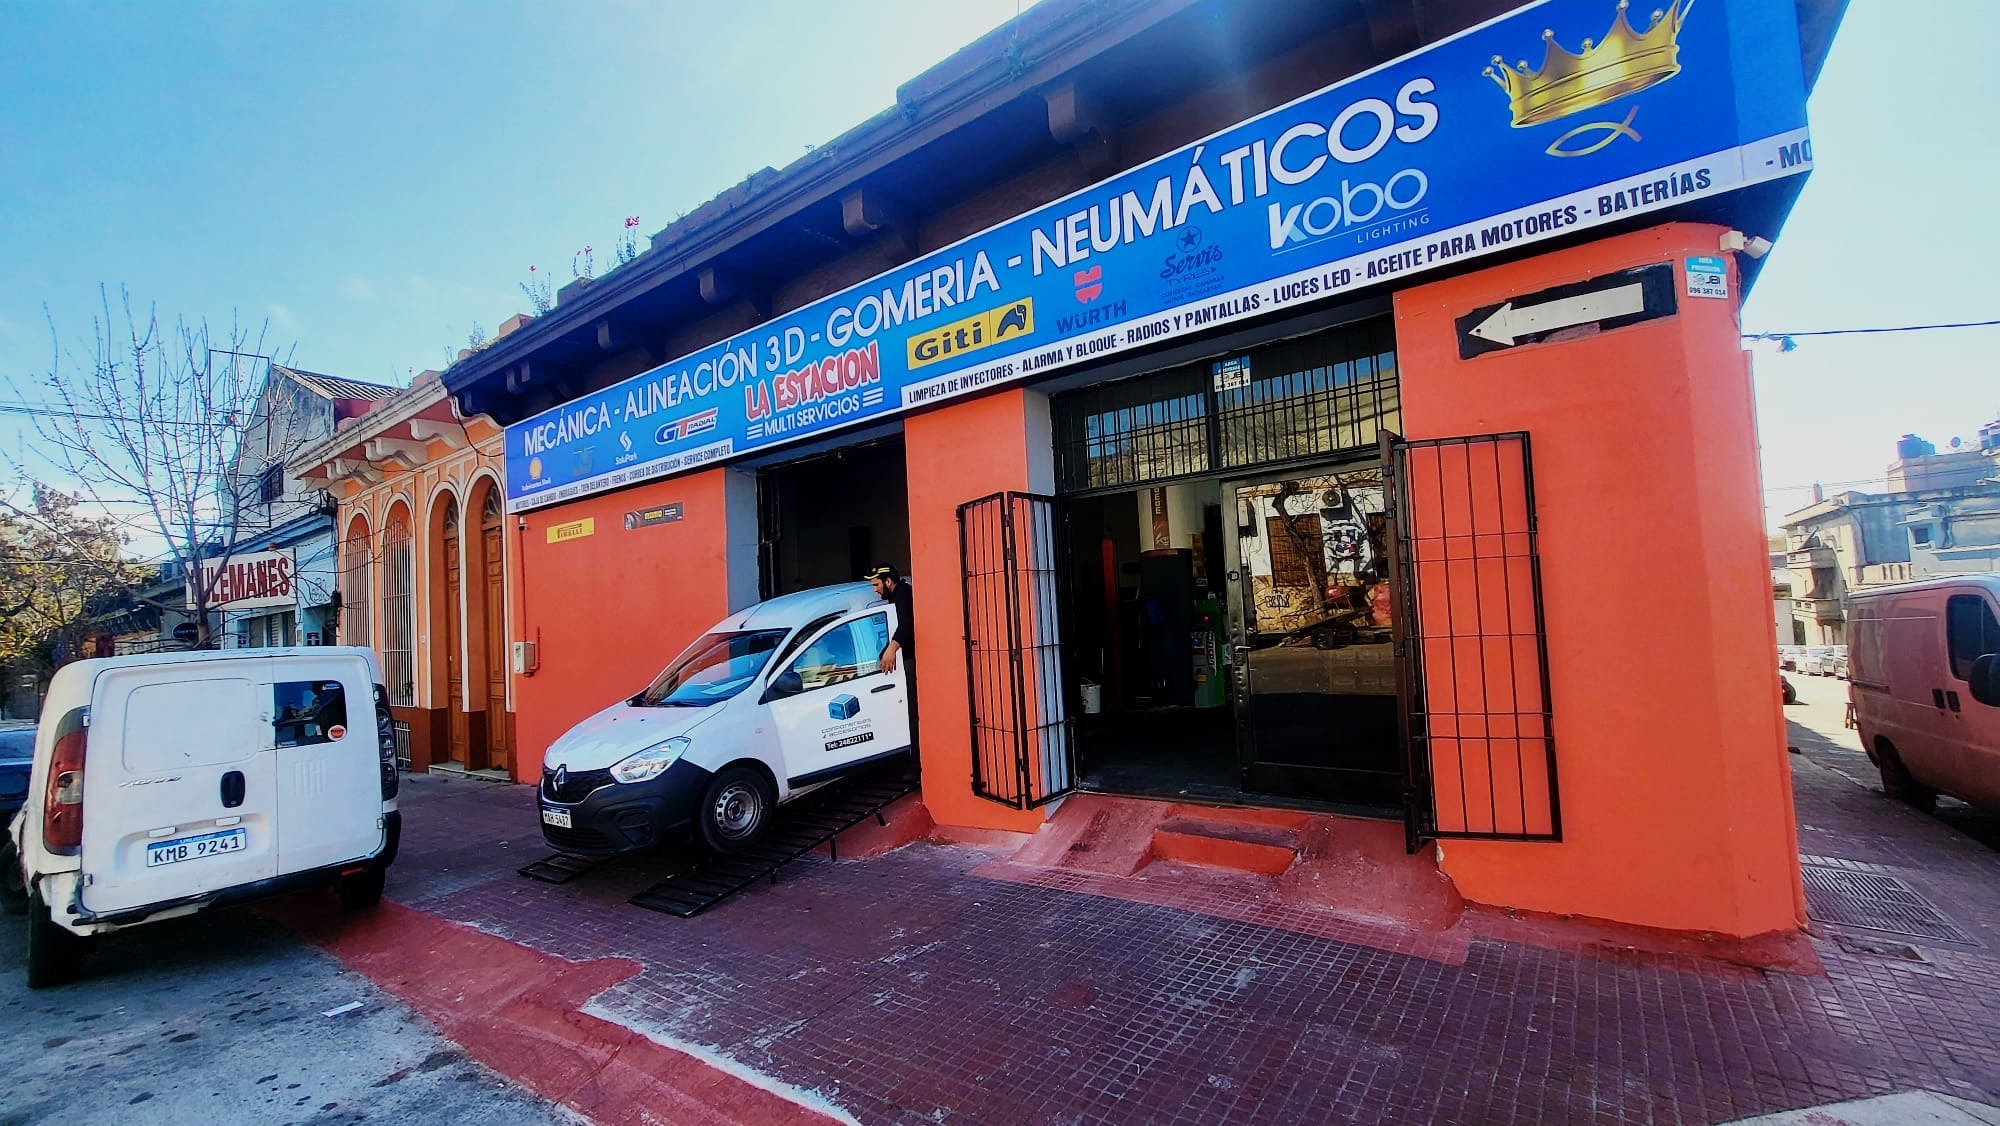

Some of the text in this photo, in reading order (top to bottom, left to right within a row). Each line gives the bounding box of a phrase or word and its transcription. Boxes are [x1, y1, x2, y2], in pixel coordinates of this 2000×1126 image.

[1357, 213, 1430, 244] LIGHTING
[524, 402, 611, 457] MECÁNICA
[624, 341, 758, 423] ALINEACIÓN
[765, 326, 805, 372] 3D
[826, 250, 1000, 348] GOMERIA
[1031, 78, 1439, 277] NEUMÁTICOS
[908, 384, 947, 403] LIMPIEZA
[948, 381, 959, 392] DE
[960, 364, 1014, 390] INYECTORES
[1022, 349, 1064, 373] ALARMA
[1066, 346, 1074, 359] Y
[1076, 334, 1118, 357] BLOQUE
[1127, 320, 1170, 344] RADIOS
[1173, 315, 1181, 331] Y
[1185, 293, 1260, 328] PANTALLAS
[1273, 277, 1319, 303] LUCES
[1323, 267, 1351, 290] LED
[1367, 248, 1423, 278] ACEITE
[1427, 234, 1476, 262] PARA
[1481, 205, 1578, 247] MOTORES
[1598, 168, 1711, 217] BATERÍAS
[1057, 300, 1127, 334] WÜRTH
[914, 321, 982, 361] Giti
[746, 340, 880, 420] LA ESTACION
[688, 416, 716, 430] RADIAL
[764, 393, 860, 436] MULTI SERVICIOS
[684, 451, 703, 466] SERVICE
[703, 444, 731, 461] COMPLETO
[154, 836, 240, 863] KMB 9241
